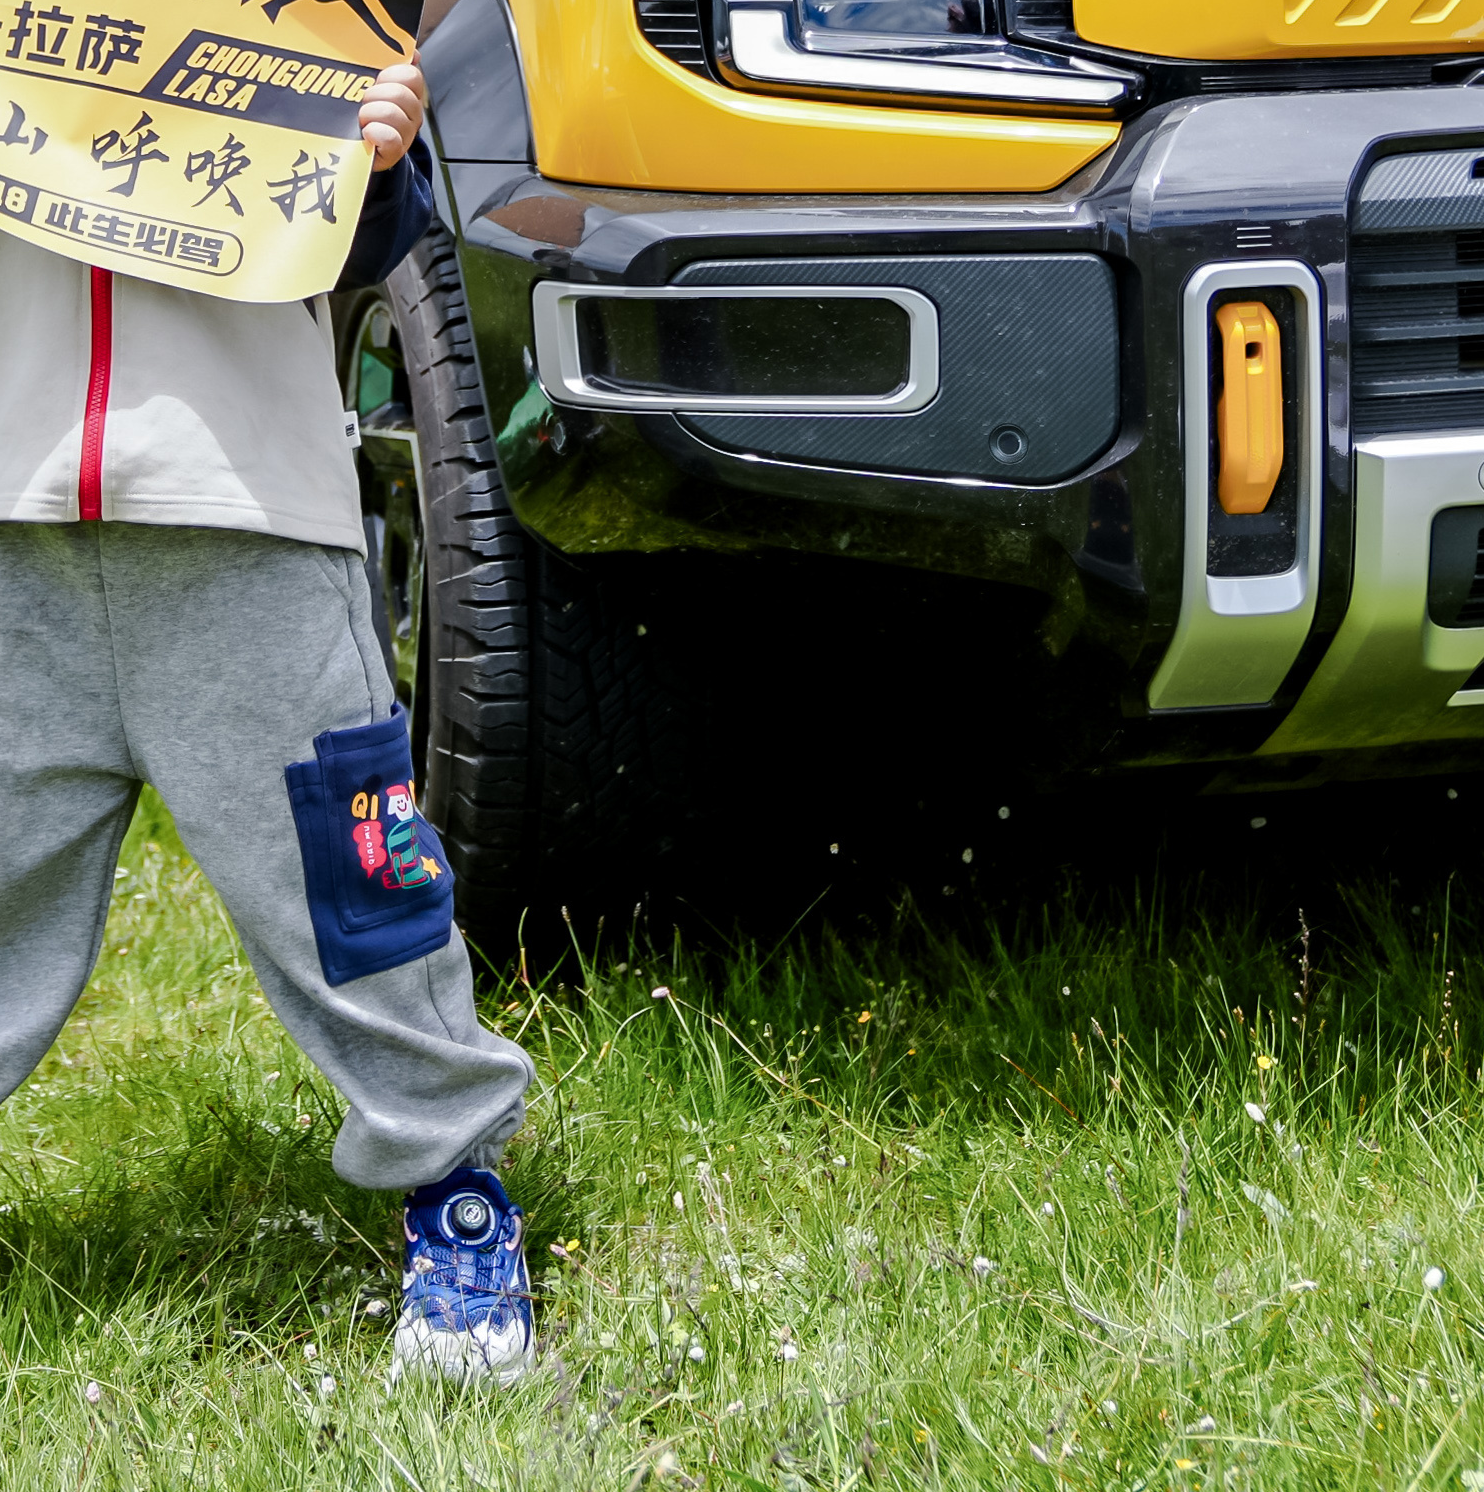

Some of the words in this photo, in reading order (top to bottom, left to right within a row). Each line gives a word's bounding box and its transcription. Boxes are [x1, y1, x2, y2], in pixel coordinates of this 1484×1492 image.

[162, 69, 258, 112] LASA
[185, 41, 376, 103] CHONGQING
[44, 200, 226, 268] 此生必驾
